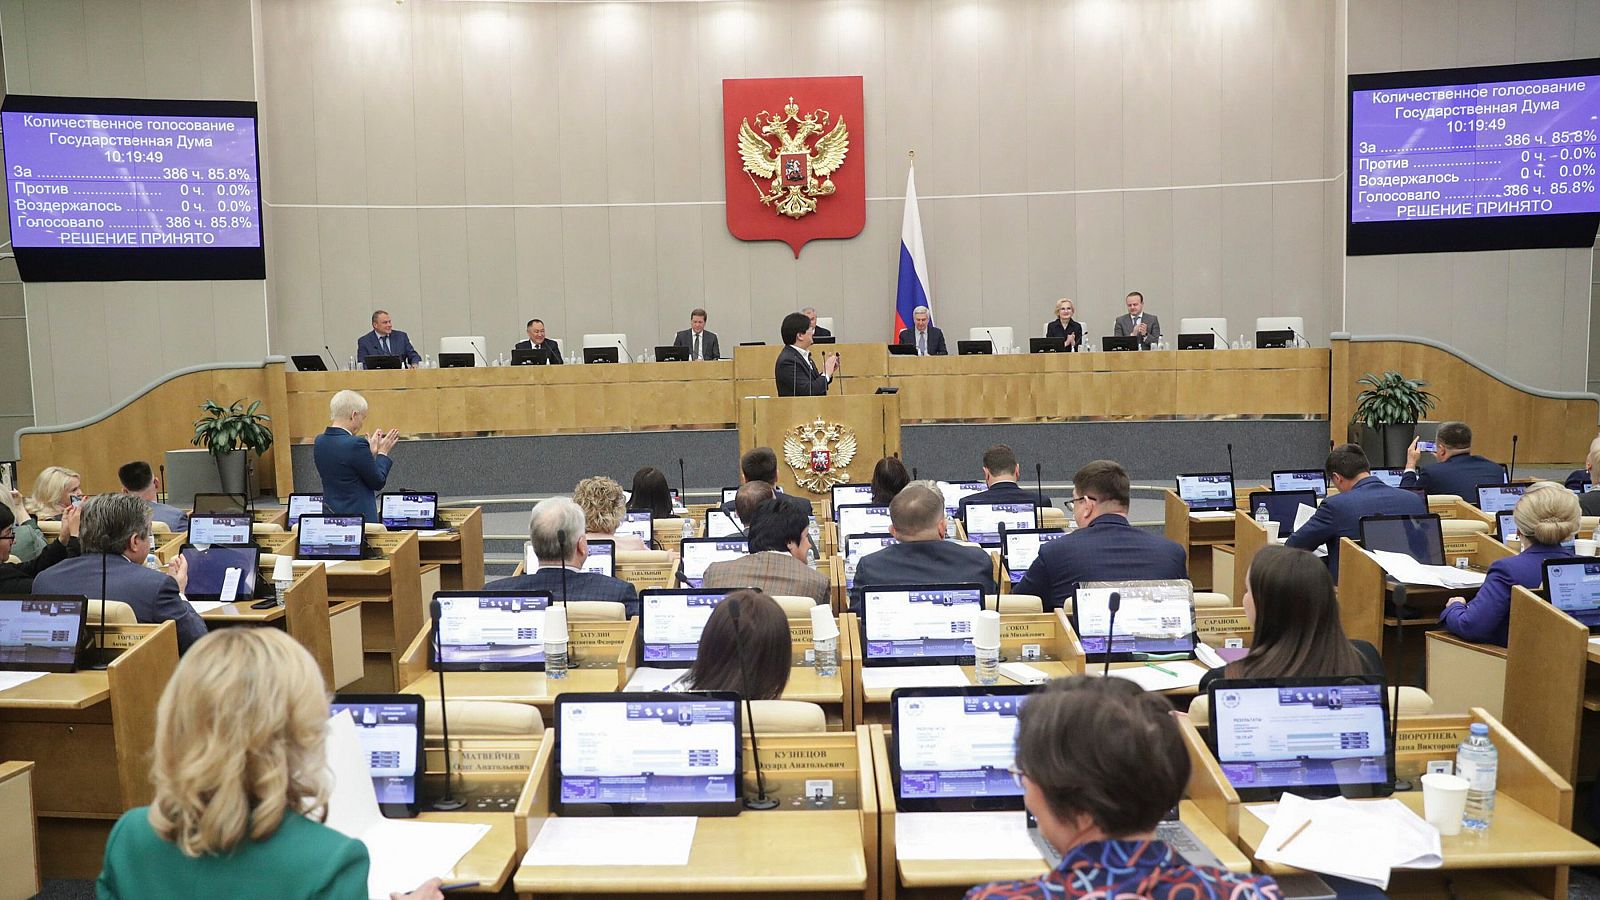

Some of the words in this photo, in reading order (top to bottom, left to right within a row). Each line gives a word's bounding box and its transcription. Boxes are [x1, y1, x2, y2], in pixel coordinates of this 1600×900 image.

[1372, 88, 1488, 104] Количественное
[1492, 81, 1586, 97] голосование
[1395, 103, 1518, 120] Государственная
[1521, 99, 1560, 114] Дума
[23, 114, 143, 130] Количественное
[147, 121, 235, 131] голосование
[1446, 118, 1507, 133] 10:19:49
[49, 132, 173, 148] Государственная
[176, 134, 213, 149] Дума
[1359, 142, 1376, 153] За
[1504, 133, 1530, 146] 386
[1534, 135, 1547, 145] ч.
[1551, 129, 1597, 143] 85.8%
[104, 150, 163, 163] 10:19:49
[1359, 158, 1409, 172] Против
[1521, 150, 1530, 162] 0
[1534, 152, 1547, 161] ч.
[1560, 146, 1597, 160] 0.0%
[13, 165, 32, 178] За
[163, 168, 188, 180] 386
[191, 171, 204, 180] ч.
[207, 168, 250, 180] 85.8%
[1359, 173, 1459, 187] Воздержалось
[1520, 167, 1530, 179] 0
[1533, 169, 1546, 178] ч.
[1559, 163, 1596, 177] 0.0%
[15, 182, 69, 196] Против
[180, 184, 189, 196] 0
[192, 187, 205, 196] ч.
[217, 184, 250, 196] 0.0%
[1359, 190, 1440, 203] Голосовало
[1503, 184, 1529, 197] 386
[1533, 186, 1545, 195] ч.
[1550, 180, 1595, 194] 85.8%
[16, 198, 122, 213] Воздержалось
[181, 200, 190, 212] 0
[193, 203, 205, 212] ч.
[218, 200, 251, 212] 0.0%
[1397, 203, 1472, 217] РЕШЕНИЕ
[1476, 199, 1553, 214] ПРИНЯТО
[18, 216, 104, 228] Голосовало
[165, 217, 190, 228] 386
[194, 219, 206, 228] ч.
[210, 216, 252, 228] 85.8%
[60, 232, 136, 244] РЕШЕНИЕ
[141, 232, 215, 244] ПРИНЯТО
[1204, 618, 1240, 626] САРАНОВА
[461, 750, 521, 760] МАТВЕЙЧЕВ
[774, 750, 827, 759] КУЗНЕЦОВ
[475, 763, 530, 771] Анатольевич
[789, 760, 845, 770] Анатольевич
